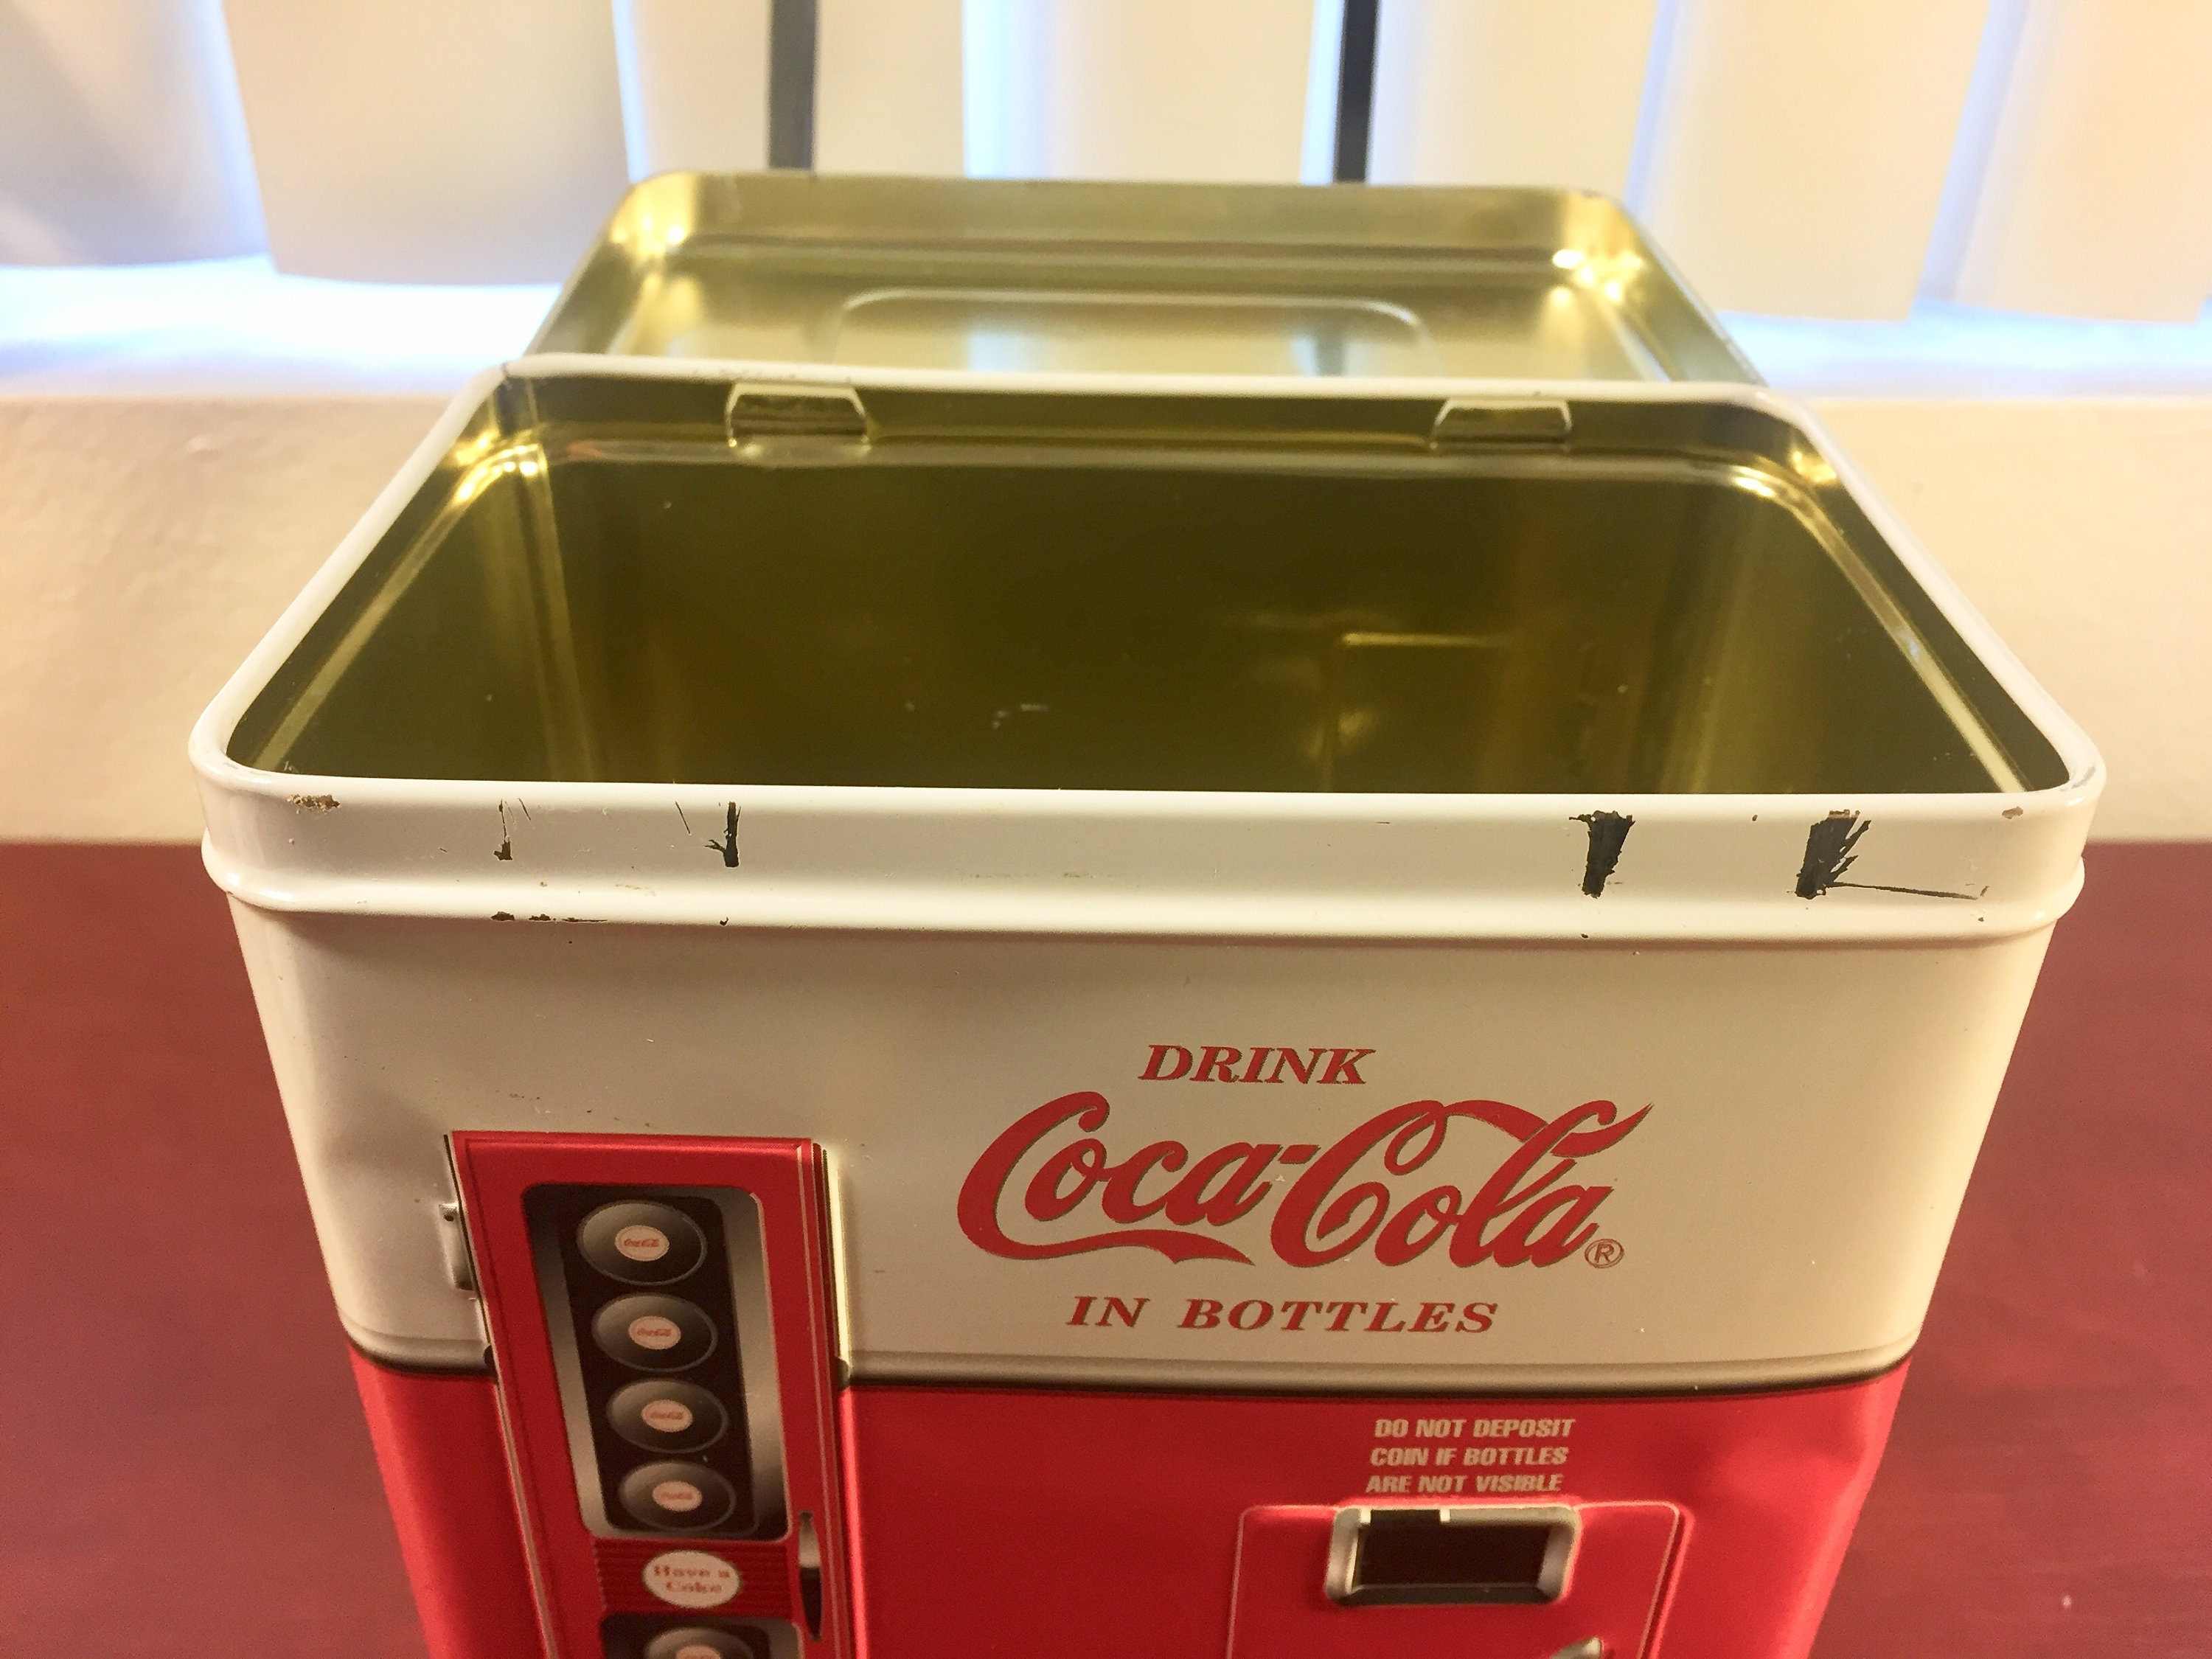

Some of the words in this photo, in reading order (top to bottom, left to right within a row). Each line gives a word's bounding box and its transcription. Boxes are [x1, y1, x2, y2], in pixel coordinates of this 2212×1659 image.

[1139, 1044, 1376, 1085] DRINK
[957, 1091, 1655, 1268] Coca-Cola
[1068, 1296, 1150, 1327] IN
[1180, 1298, 1498, 1333] BOTTLES
[1374, 1419, 1409, 1438] DO
[1416, 1419, 1467, 1438] NOT
[1472, 1419, 1576, 1439] DEPOSIT
[1370, 1448, 1428, 1466] COIN
[1435, 1448, 1457, 1466] IF
[1463, 1447, 1569, 1466] BOTTLES
[1366, 1476, 1412, 1493] ARE
[1418, 1475, 1468, 1492] NOT
[1475, 1475, 1564, 1492] VISIBLE
